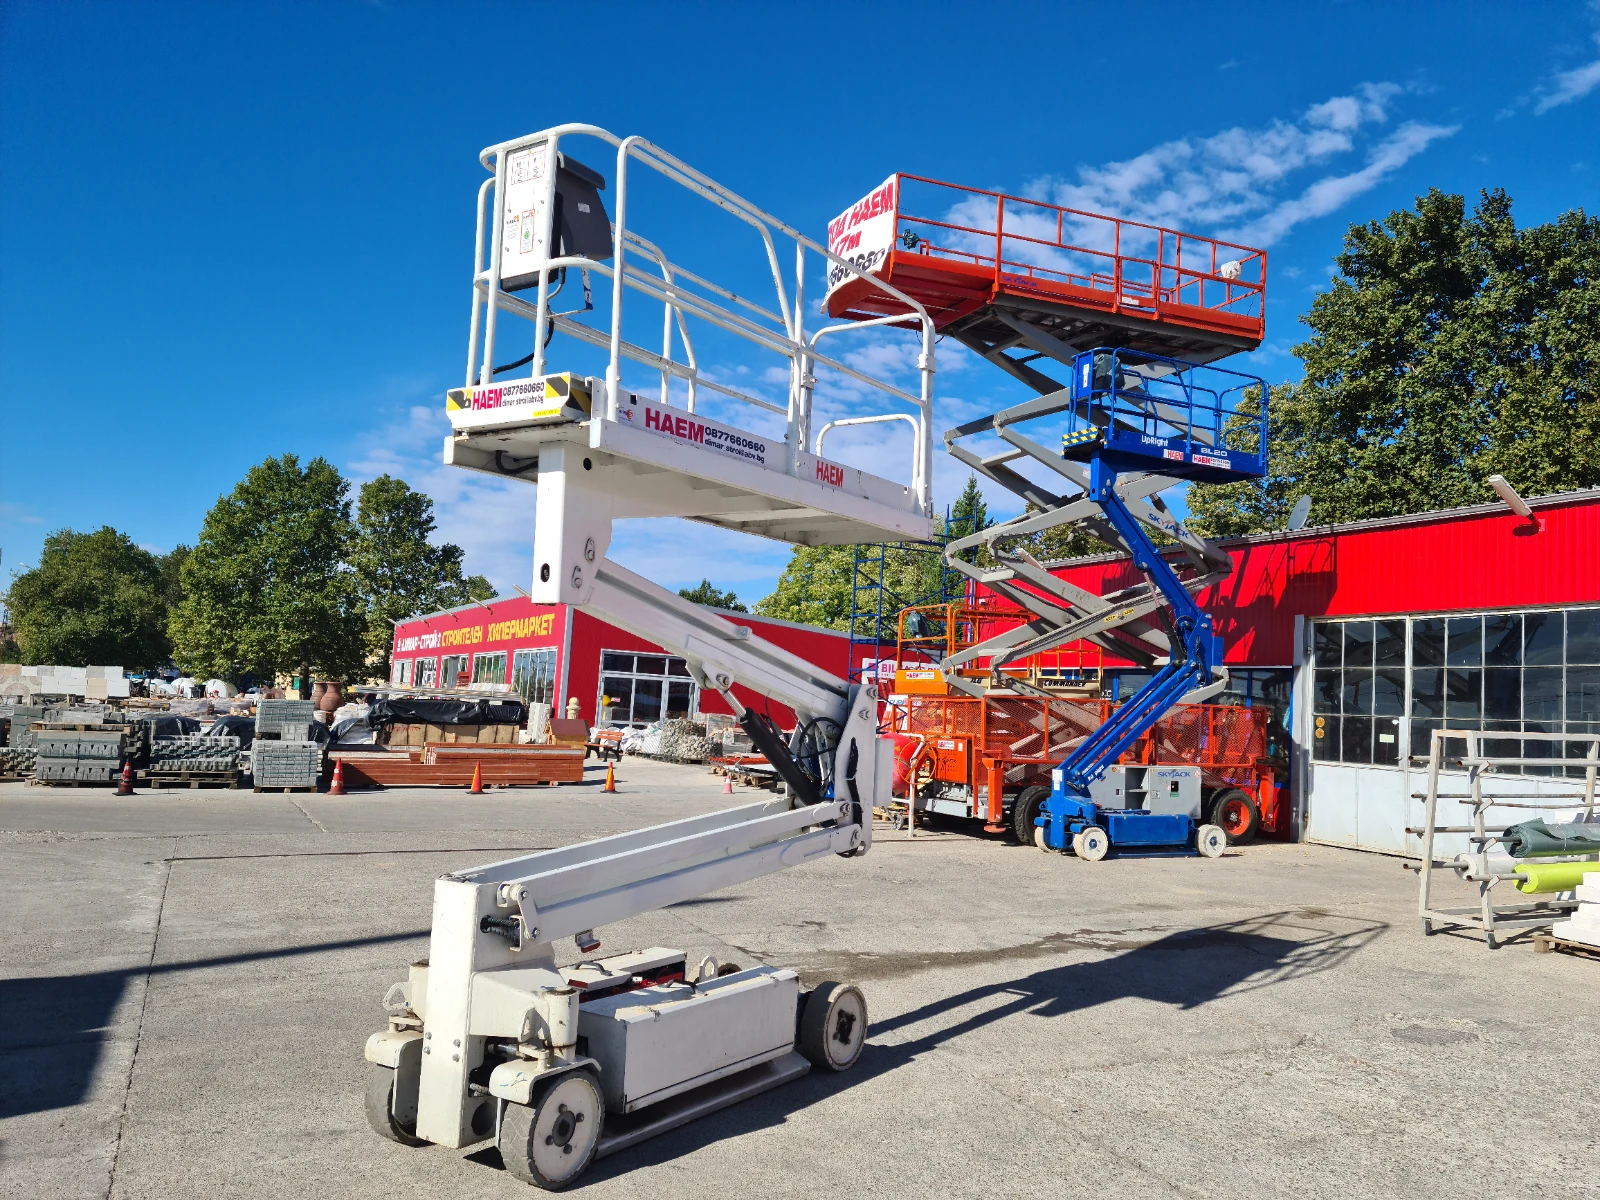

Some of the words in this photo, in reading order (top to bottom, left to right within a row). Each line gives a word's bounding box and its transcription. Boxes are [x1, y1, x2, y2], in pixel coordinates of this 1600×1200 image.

[502, 382, 545, 397] 0877660660
[645, 407, 705, 444] НАЕМ
[704, 426, 766, 454] 0877660660
[1141, 435, 1169, 447] UpRight
[815, 460, 845, 488] НАЕМ
[1147, 512, 1189, 539] SKYJACK
[441, 625, 483, 647] СТРОИТЕЛЕН
[487, 613, 555, 643] ХИПЕРМАРКЕТ
[1157, 770, 1191, 779] SKYJACK
